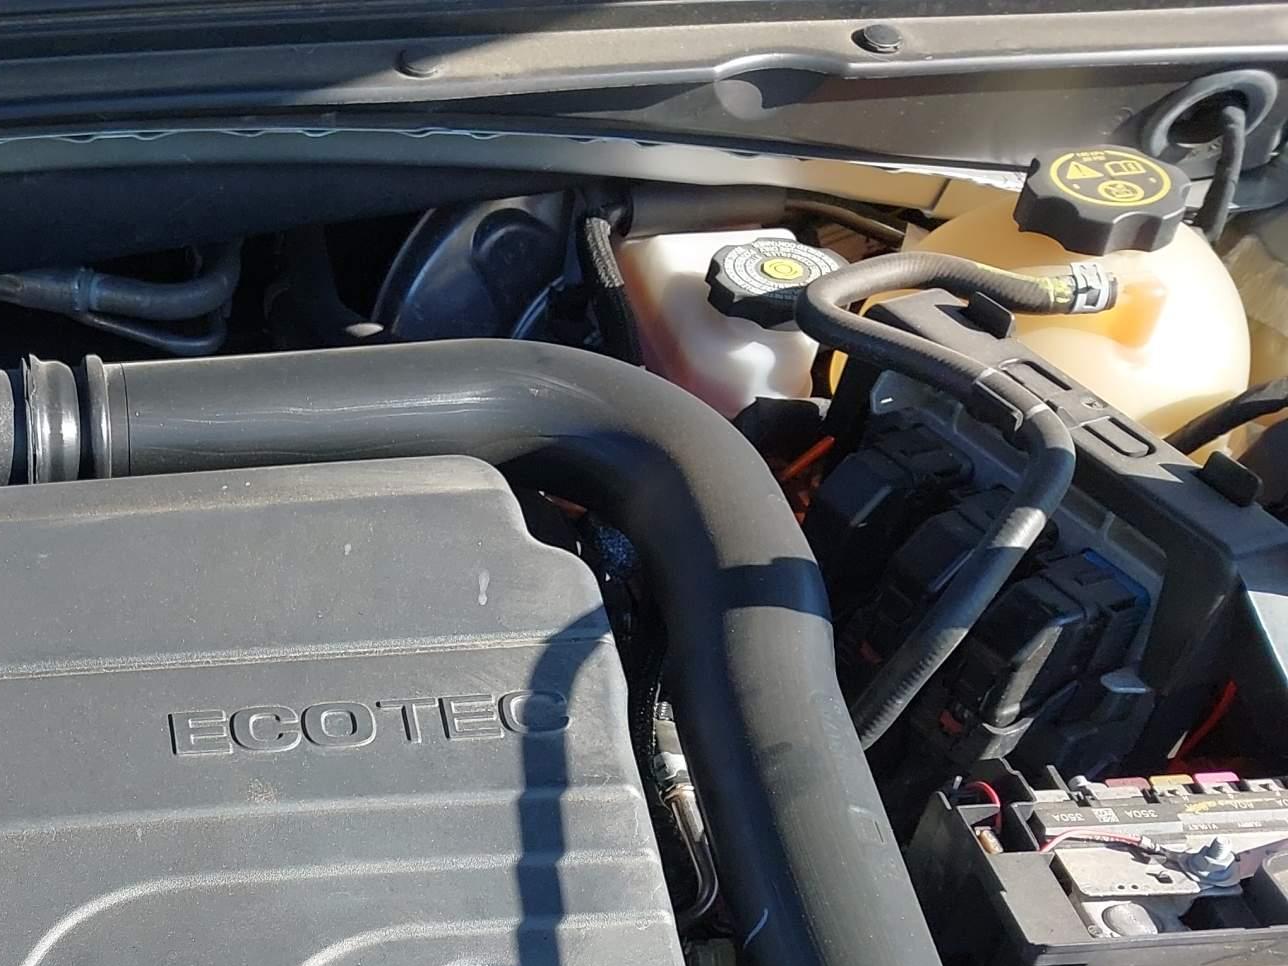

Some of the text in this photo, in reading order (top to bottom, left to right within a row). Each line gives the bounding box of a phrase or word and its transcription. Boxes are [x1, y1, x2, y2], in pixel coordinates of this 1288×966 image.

[167, 689, 572, 757] ECOTEC
[1051, 813, 1084, 823] 350A
[1124, 809, 1158, 819] 350A
